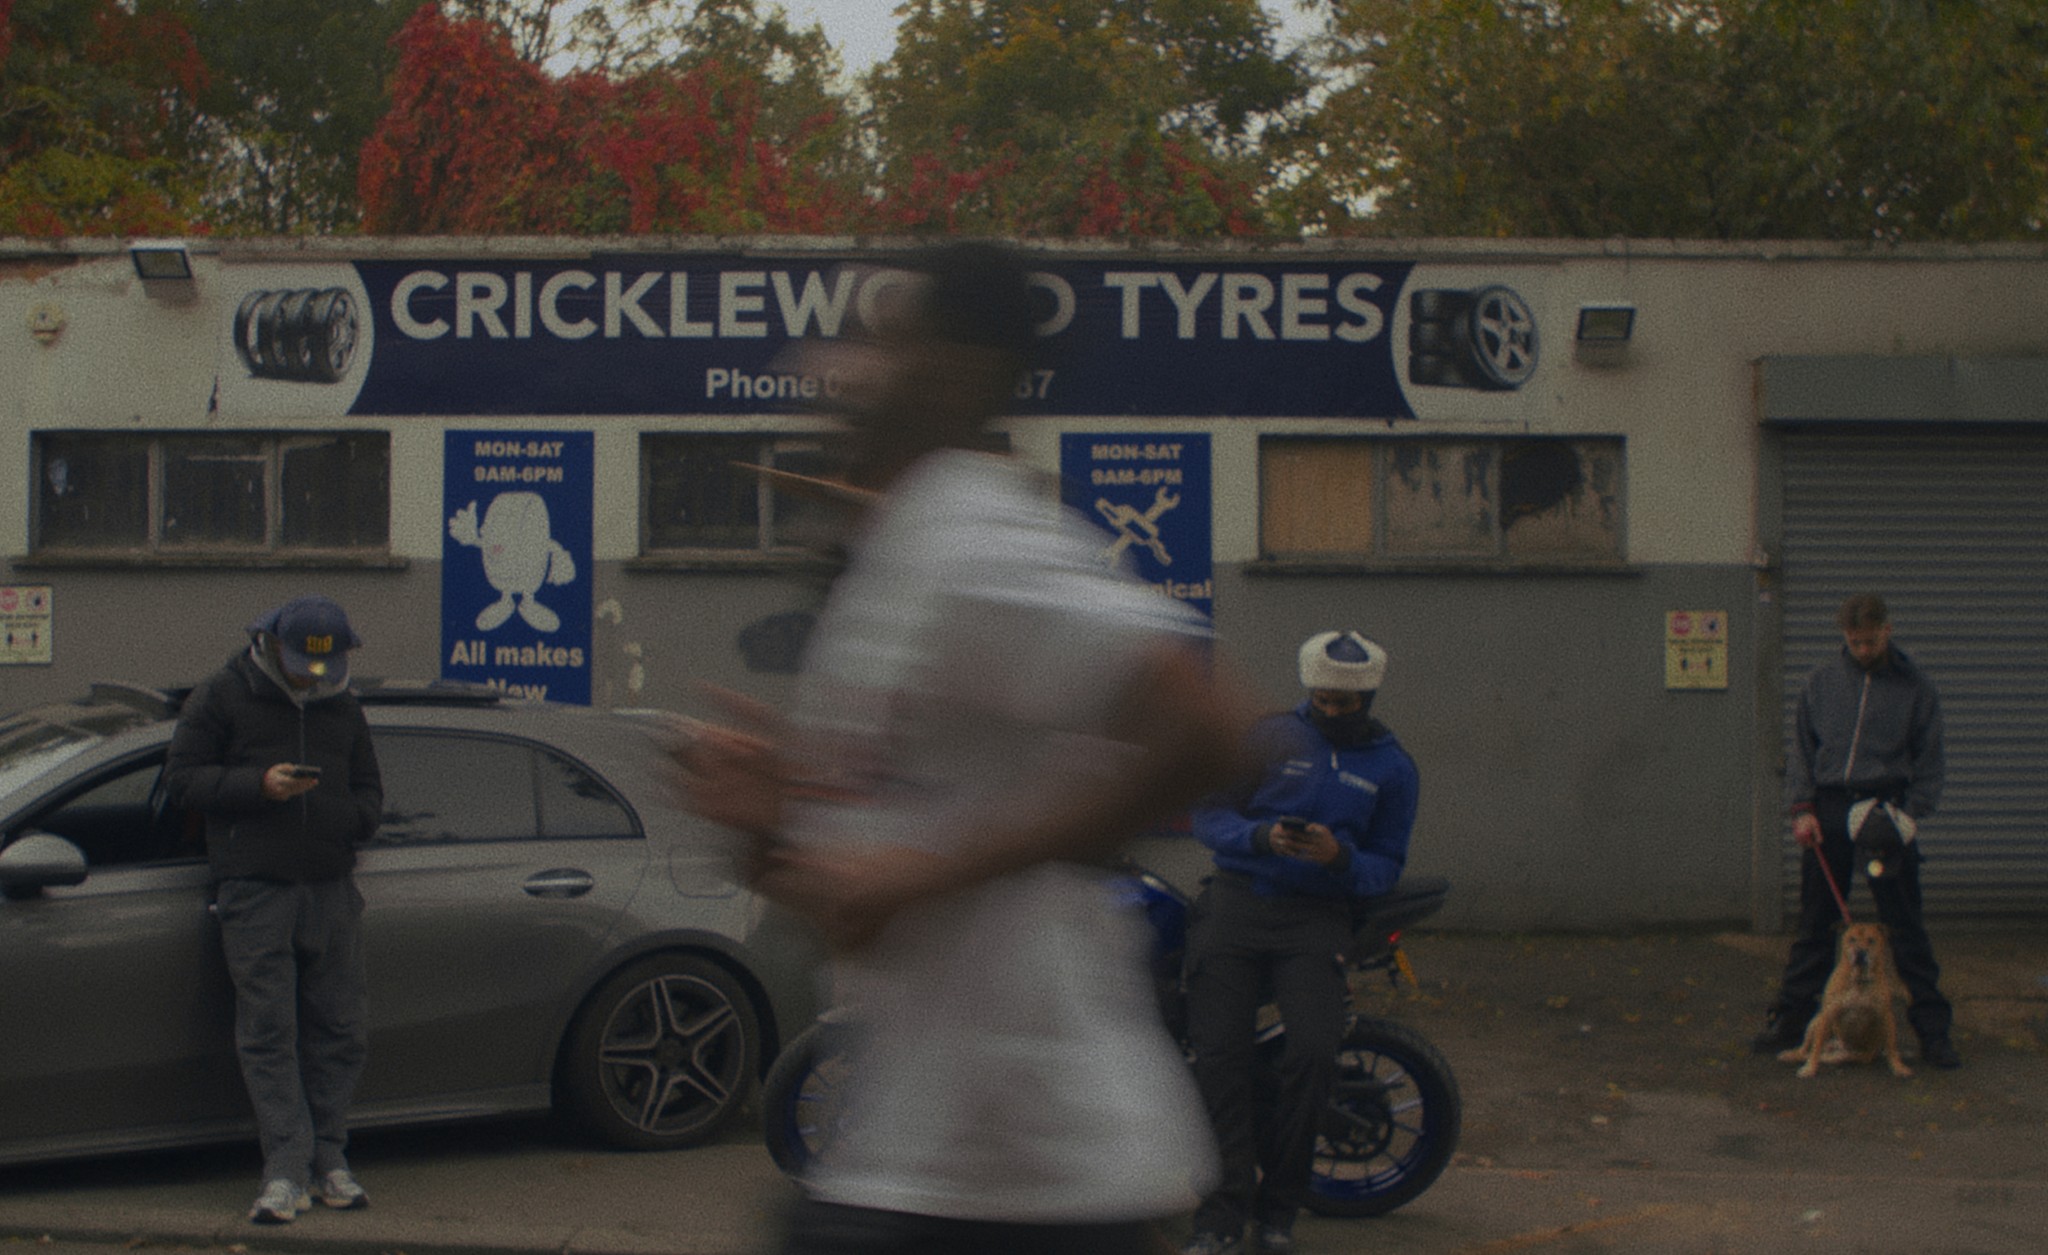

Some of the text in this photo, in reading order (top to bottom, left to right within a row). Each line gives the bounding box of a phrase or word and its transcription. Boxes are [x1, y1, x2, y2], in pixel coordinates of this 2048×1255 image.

[1104, 271, 1385, 343] TYRES
[706, 368, 817, 399] Phone
[474, 440, 564, 458] MON-SAT
[1091, 443, 1184, 461] MON-SAT
[473, 465, 564, 483] 9AM-6PM
[450, 640, 585, 668] All makes
